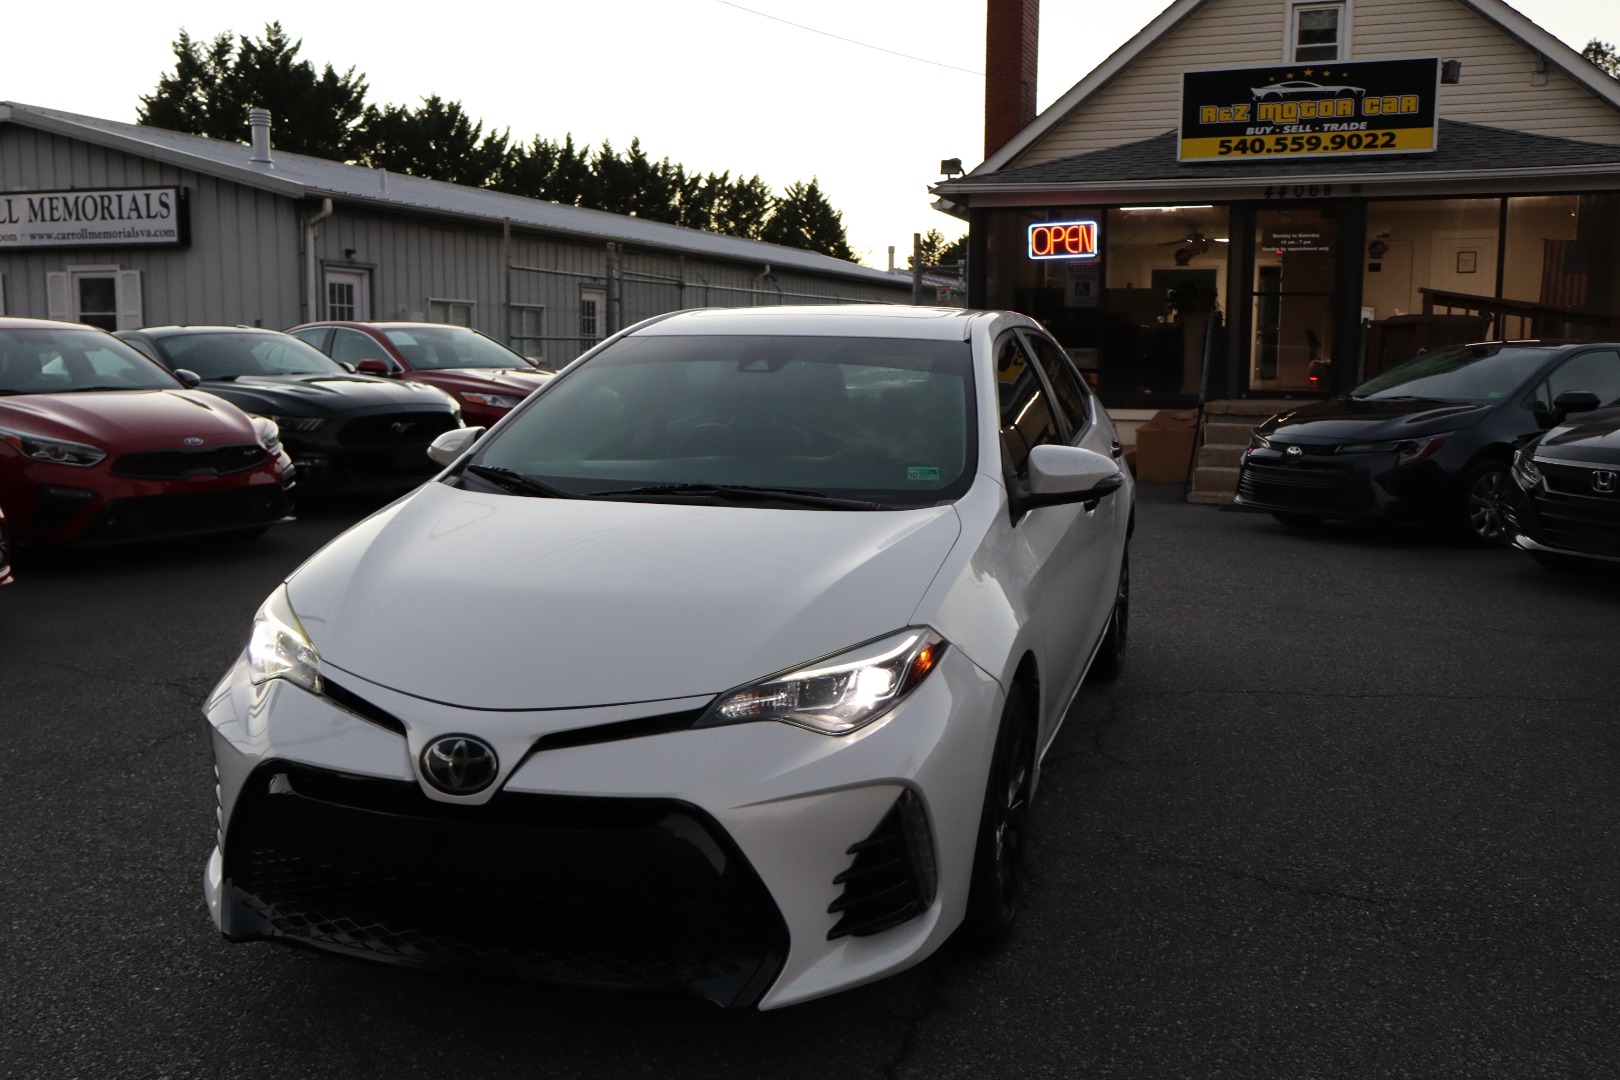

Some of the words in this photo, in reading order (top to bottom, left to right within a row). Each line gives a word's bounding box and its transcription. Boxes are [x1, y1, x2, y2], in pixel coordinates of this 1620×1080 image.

[1200, 103, 1251, 124] A&Z
[1246, 126, 1274, 135] BUY
[1283, 124, 1312, 134] SELL
[1323, 121, 1368, 132] TRADE
[1218, 132, 1396, 155] 540.559.9022
[27, 192, 171, 223] MEMORIALS
[29, 227, 176, 241] www.carrollmemorialsva.com
[1032, 225, 1095, 255] OPEN
